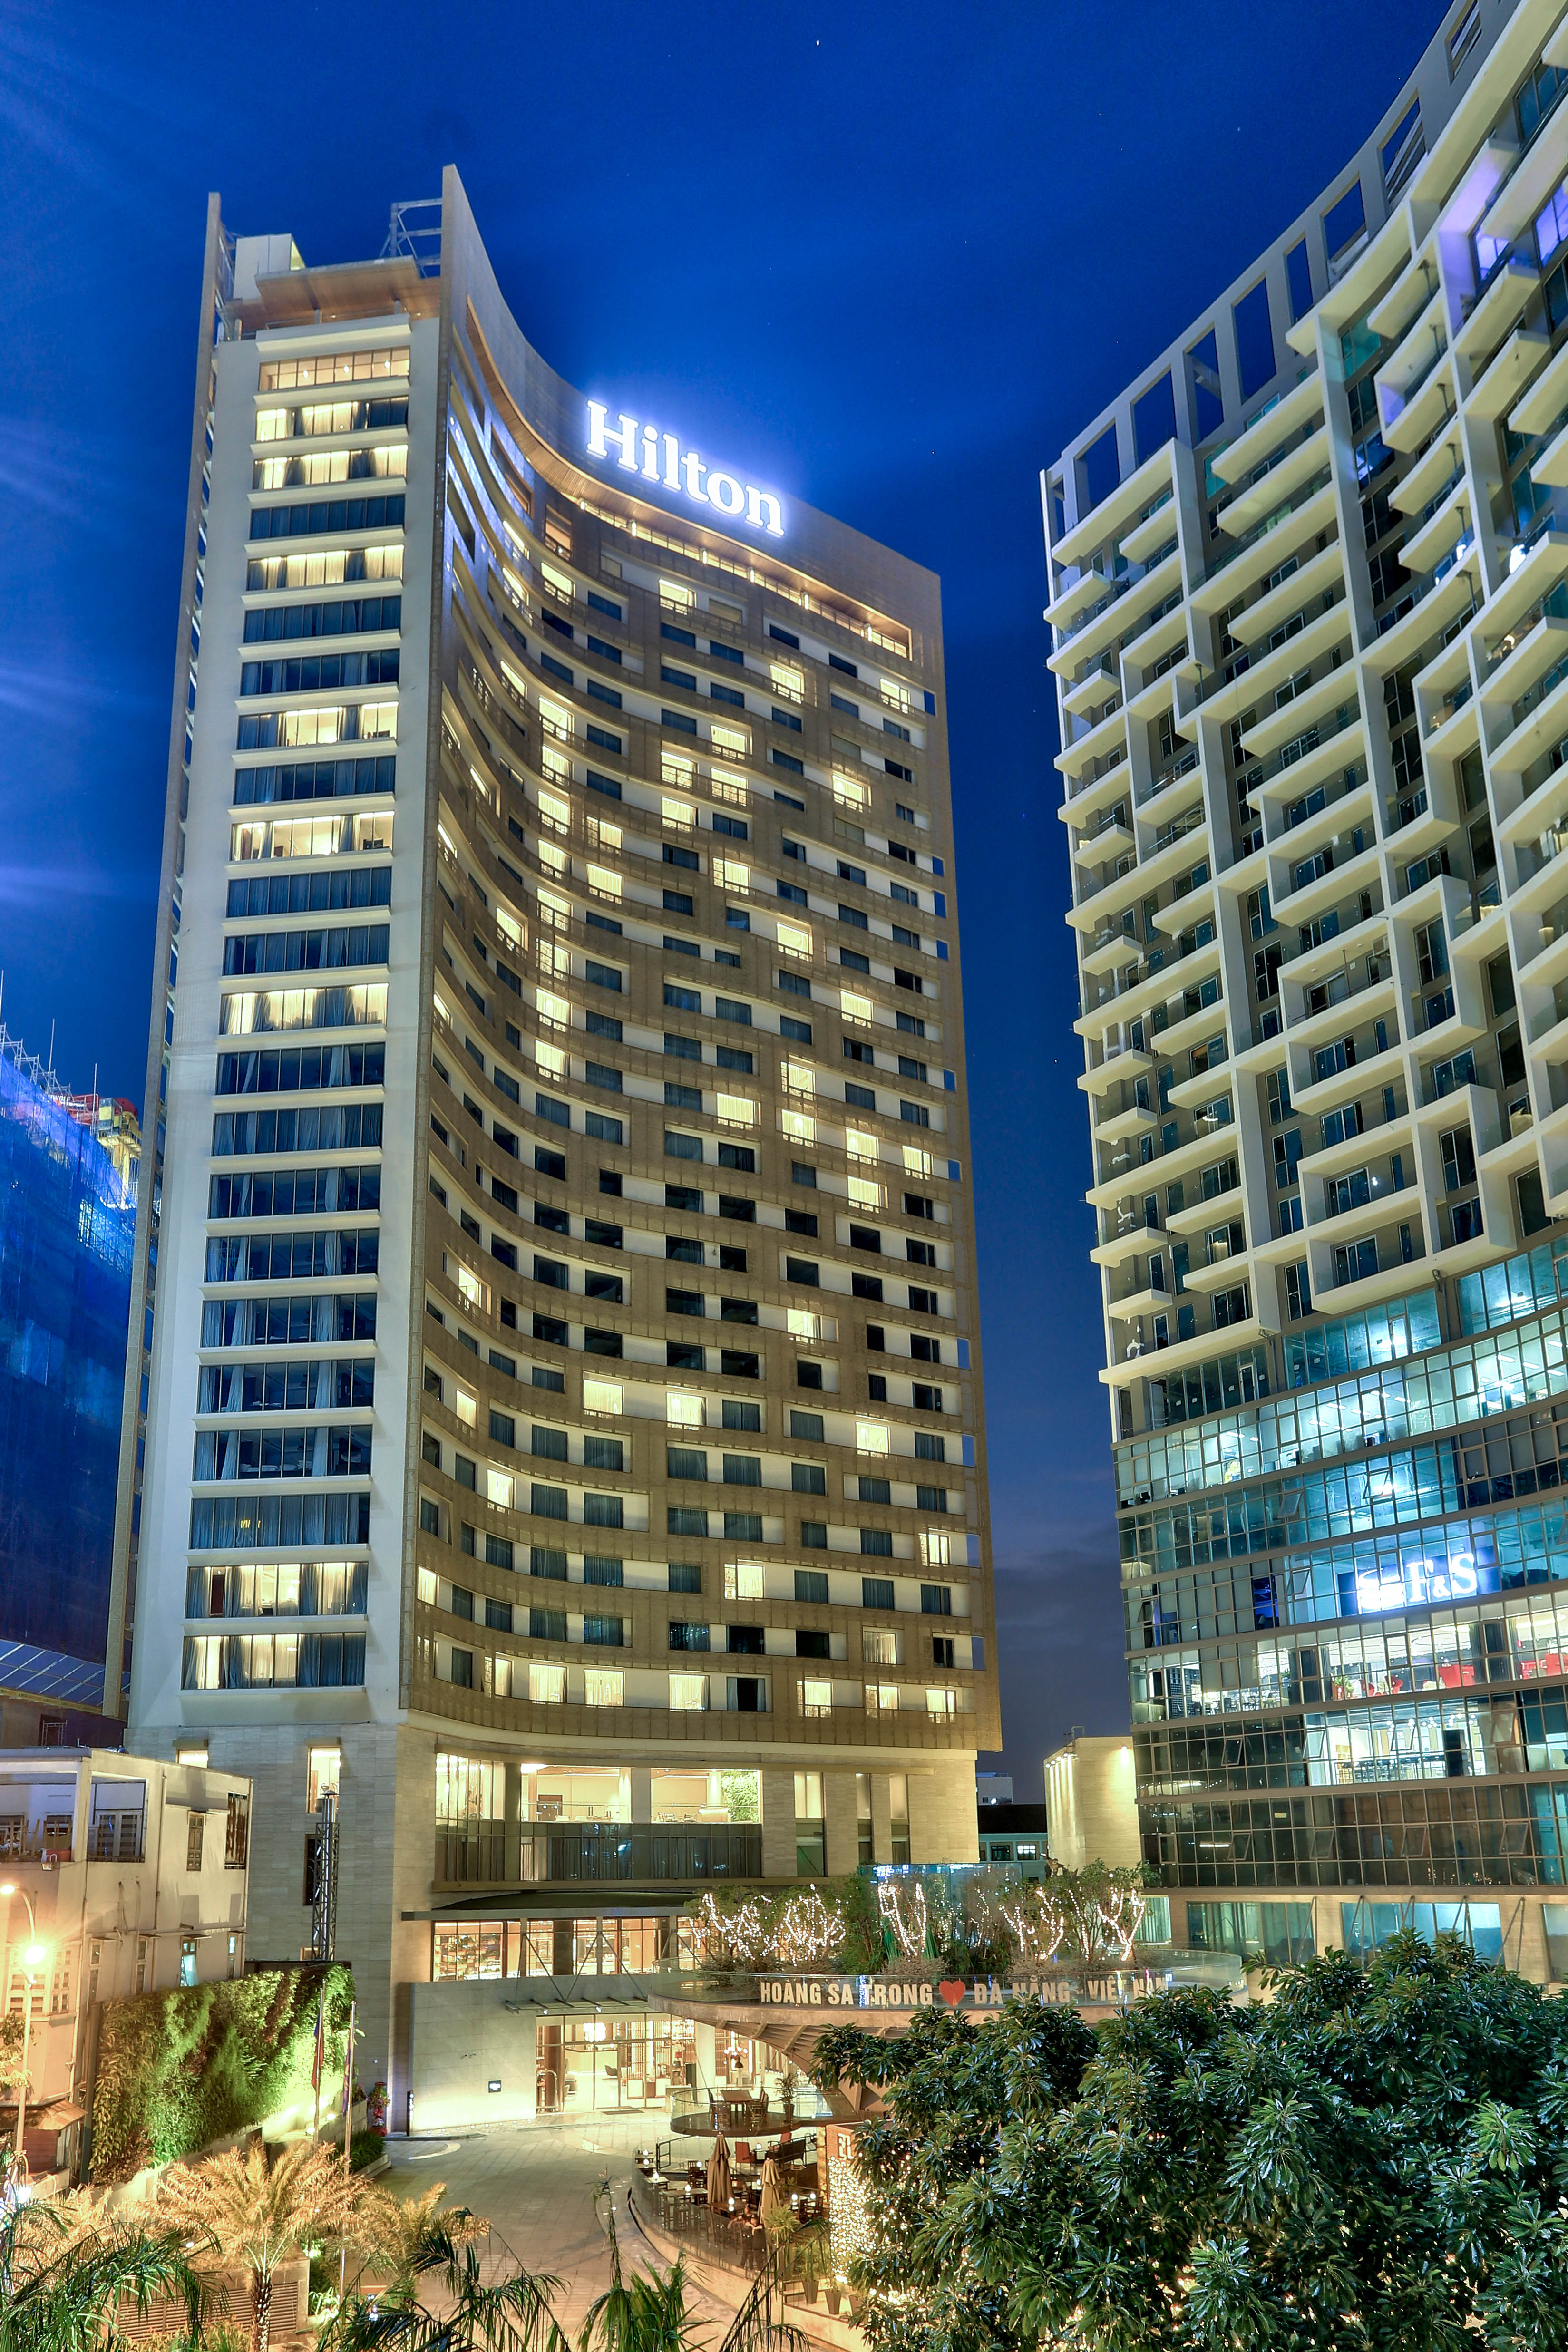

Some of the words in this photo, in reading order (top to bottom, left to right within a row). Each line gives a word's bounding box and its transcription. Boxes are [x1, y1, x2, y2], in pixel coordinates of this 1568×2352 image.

[587, 399, 785, 536] Hilton
[828, 1983, 854, 2005] SA
[863, 1983, 933, 2005] TRONG
